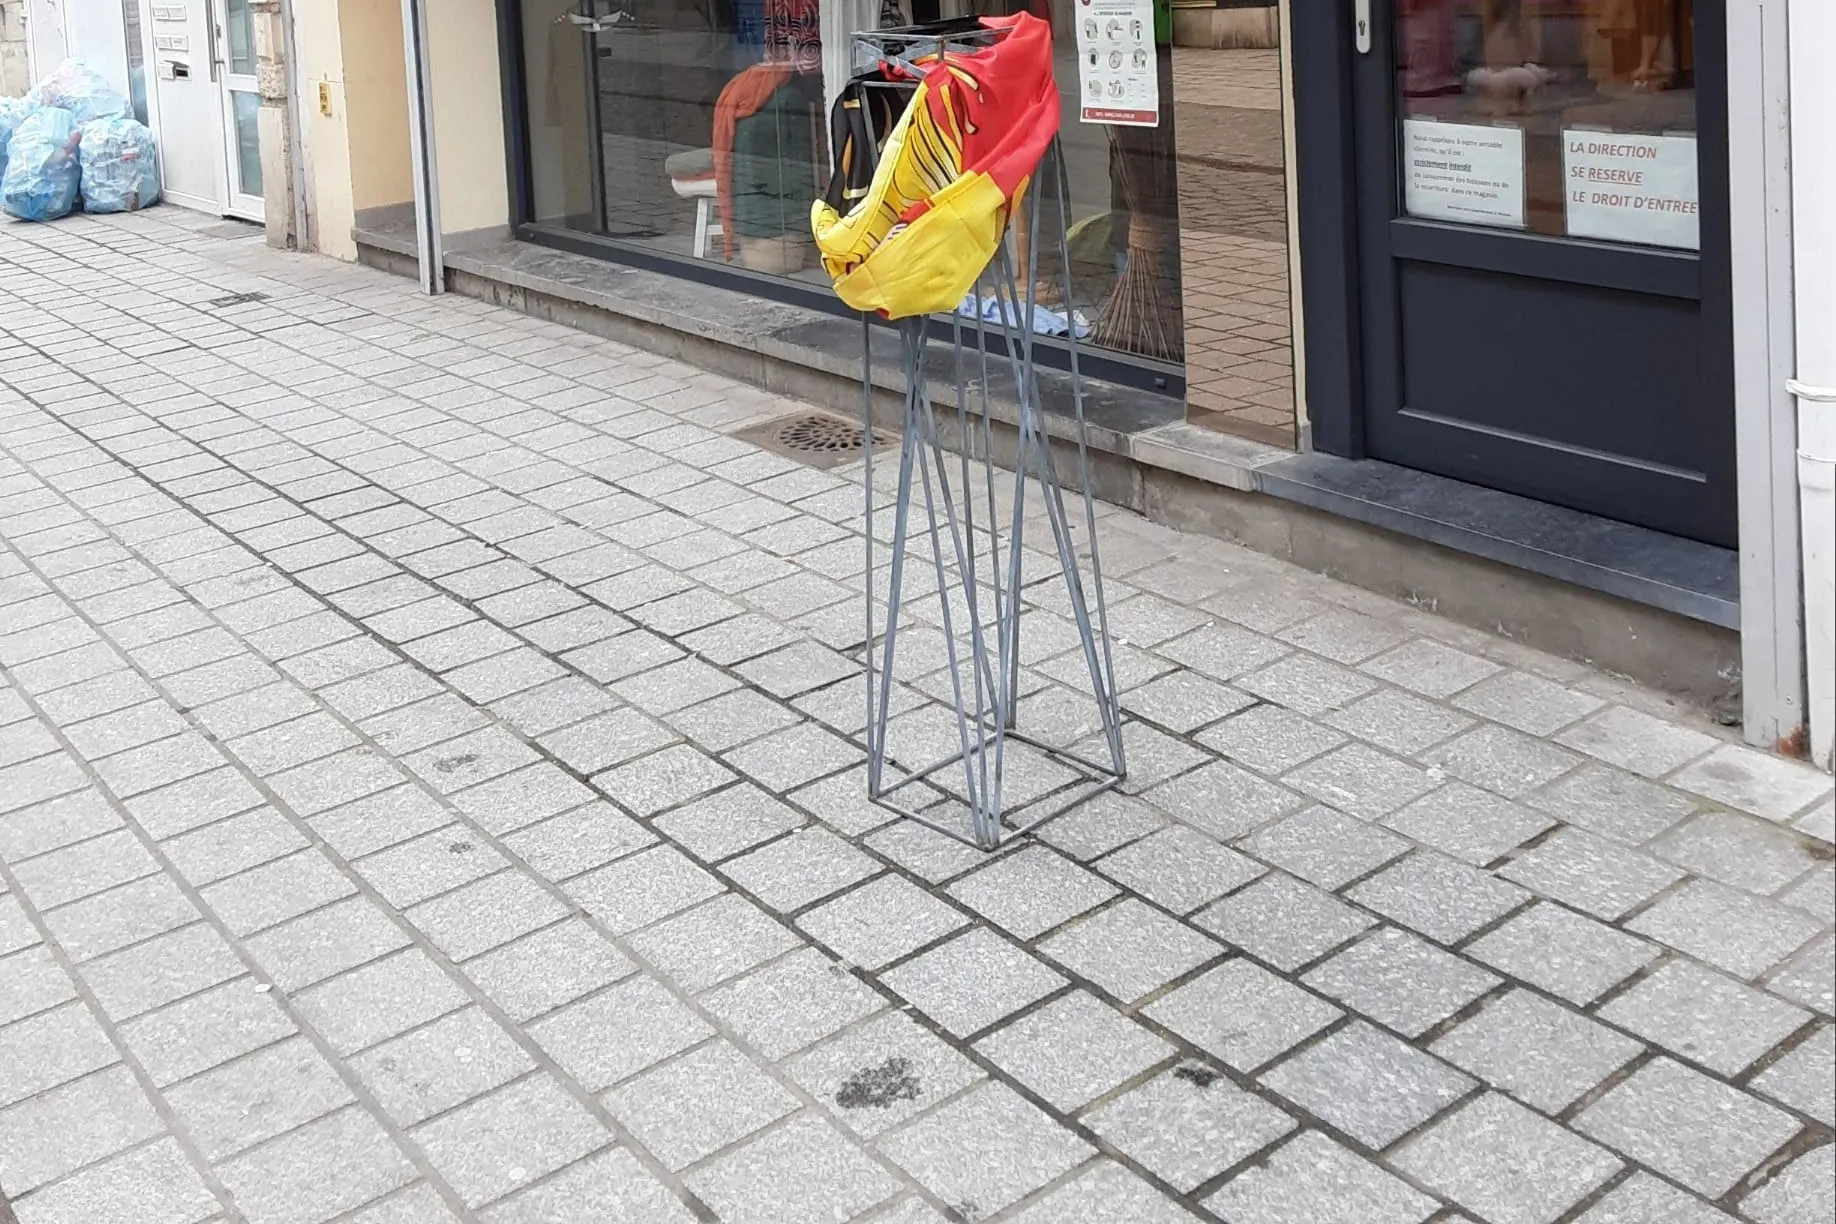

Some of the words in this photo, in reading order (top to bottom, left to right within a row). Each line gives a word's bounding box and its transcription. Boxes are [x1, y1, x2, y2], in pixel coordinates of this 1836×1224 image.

[1569, 141, 1585, 153] LA
[1588, 143, 1657, 159] DIRECTION
[1571, 166, 1585, 178] SE
[1588, 168, 1644, 184] RESERVE
[1572, 191, 1586, 203] LE
[1592, 192, 1632, 207] DROIT
[1633, 196, 1698, 214] D'ENTREE
